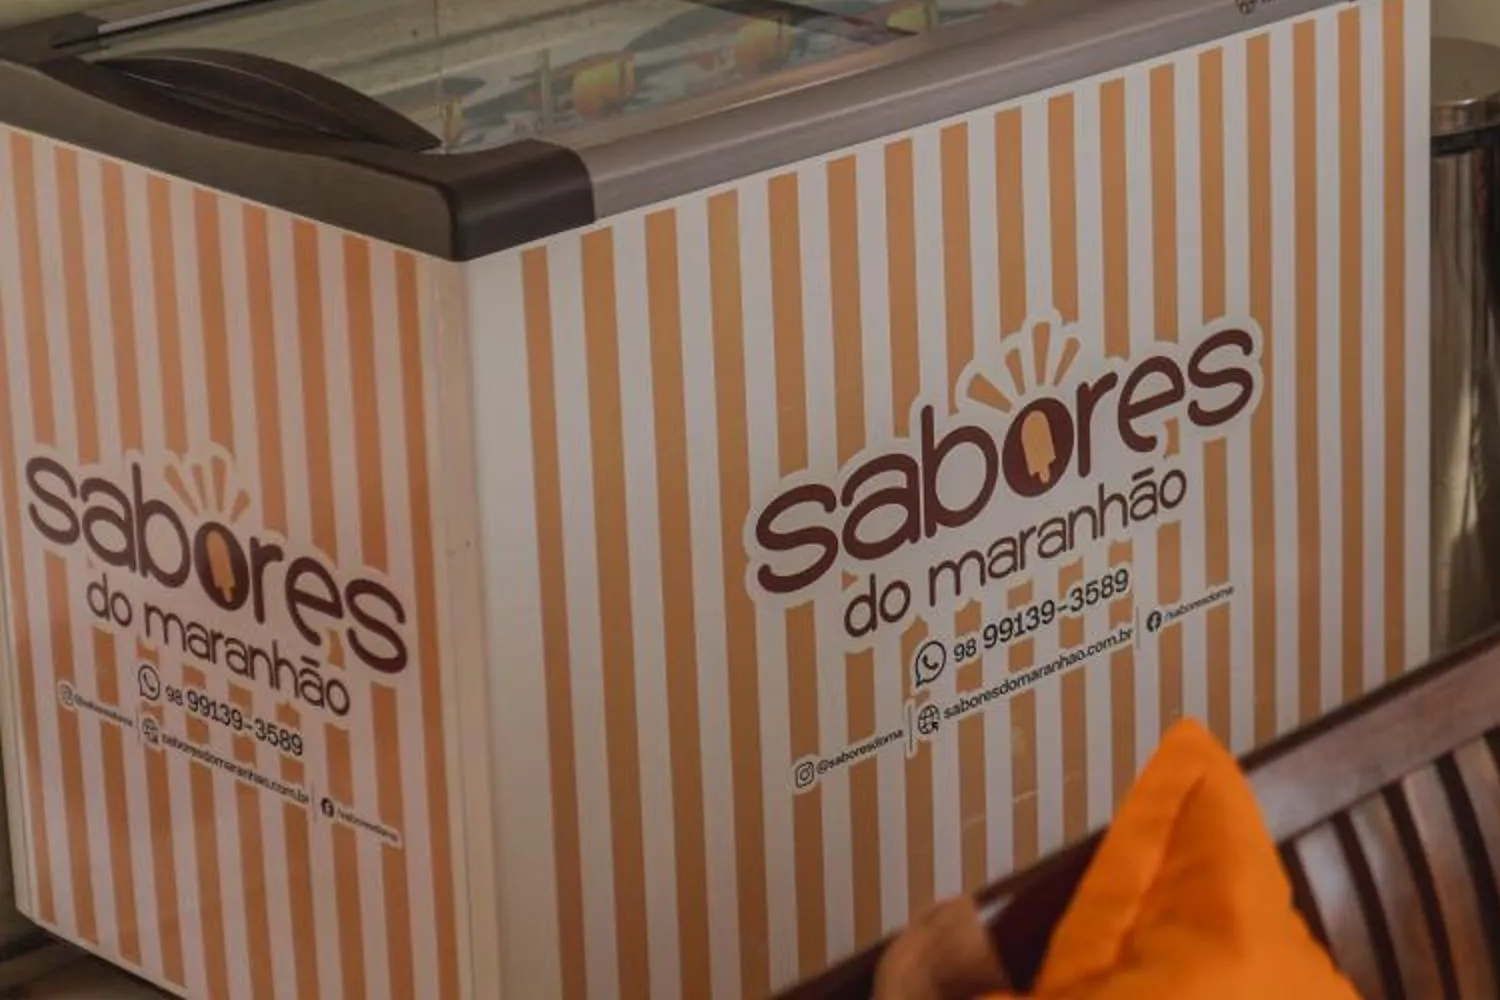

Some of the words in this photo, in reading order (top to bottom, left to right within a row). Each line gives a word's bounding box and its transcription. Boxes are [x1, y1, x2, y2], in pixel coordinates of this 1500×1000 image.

[755, 328, 1254, 593] sabores
[25, 456, 408, 674] sabores
[843, 573, 911, 638] do
[929, 467, 1188, 607] maranhão
[952, 638, 977, 663] 98
[983, 568, 1130, 649] 99139-3589
[87, 573, 132, 628] do
[144, 601, 350, 716] maranhão
[943, 627, 1133, 720] saboresdomaranhao.com.br
[165, 685, 184, 707] 98
[187, 689, 303, 757] 99139-3589
